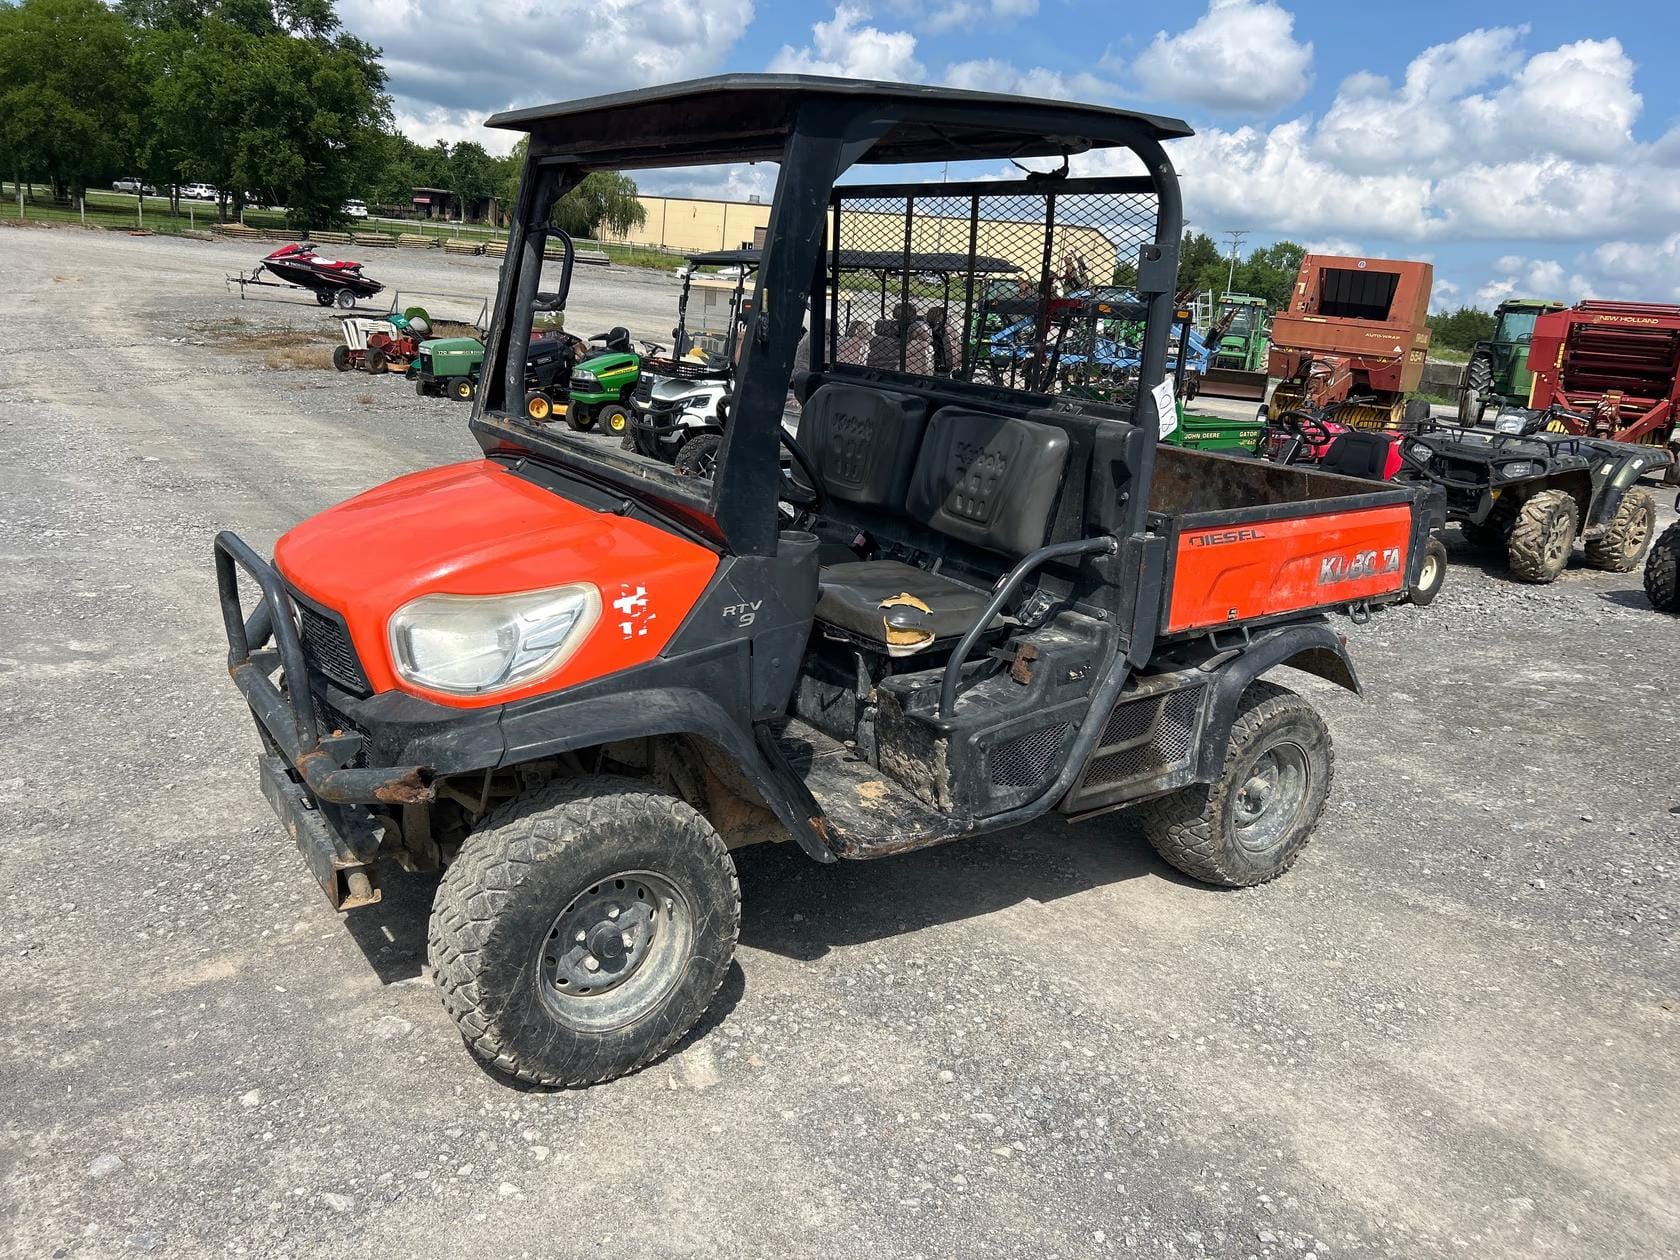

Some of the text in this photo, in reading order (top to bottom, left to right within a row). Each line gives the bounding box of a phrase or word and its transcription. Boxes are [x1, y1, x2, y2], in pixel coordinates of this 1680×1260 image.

[1620, 316, 1659, 324] HOLLAND
[1189, 530, 1265, 547] DIESEL
[722, 600, 763, 617] RTV
